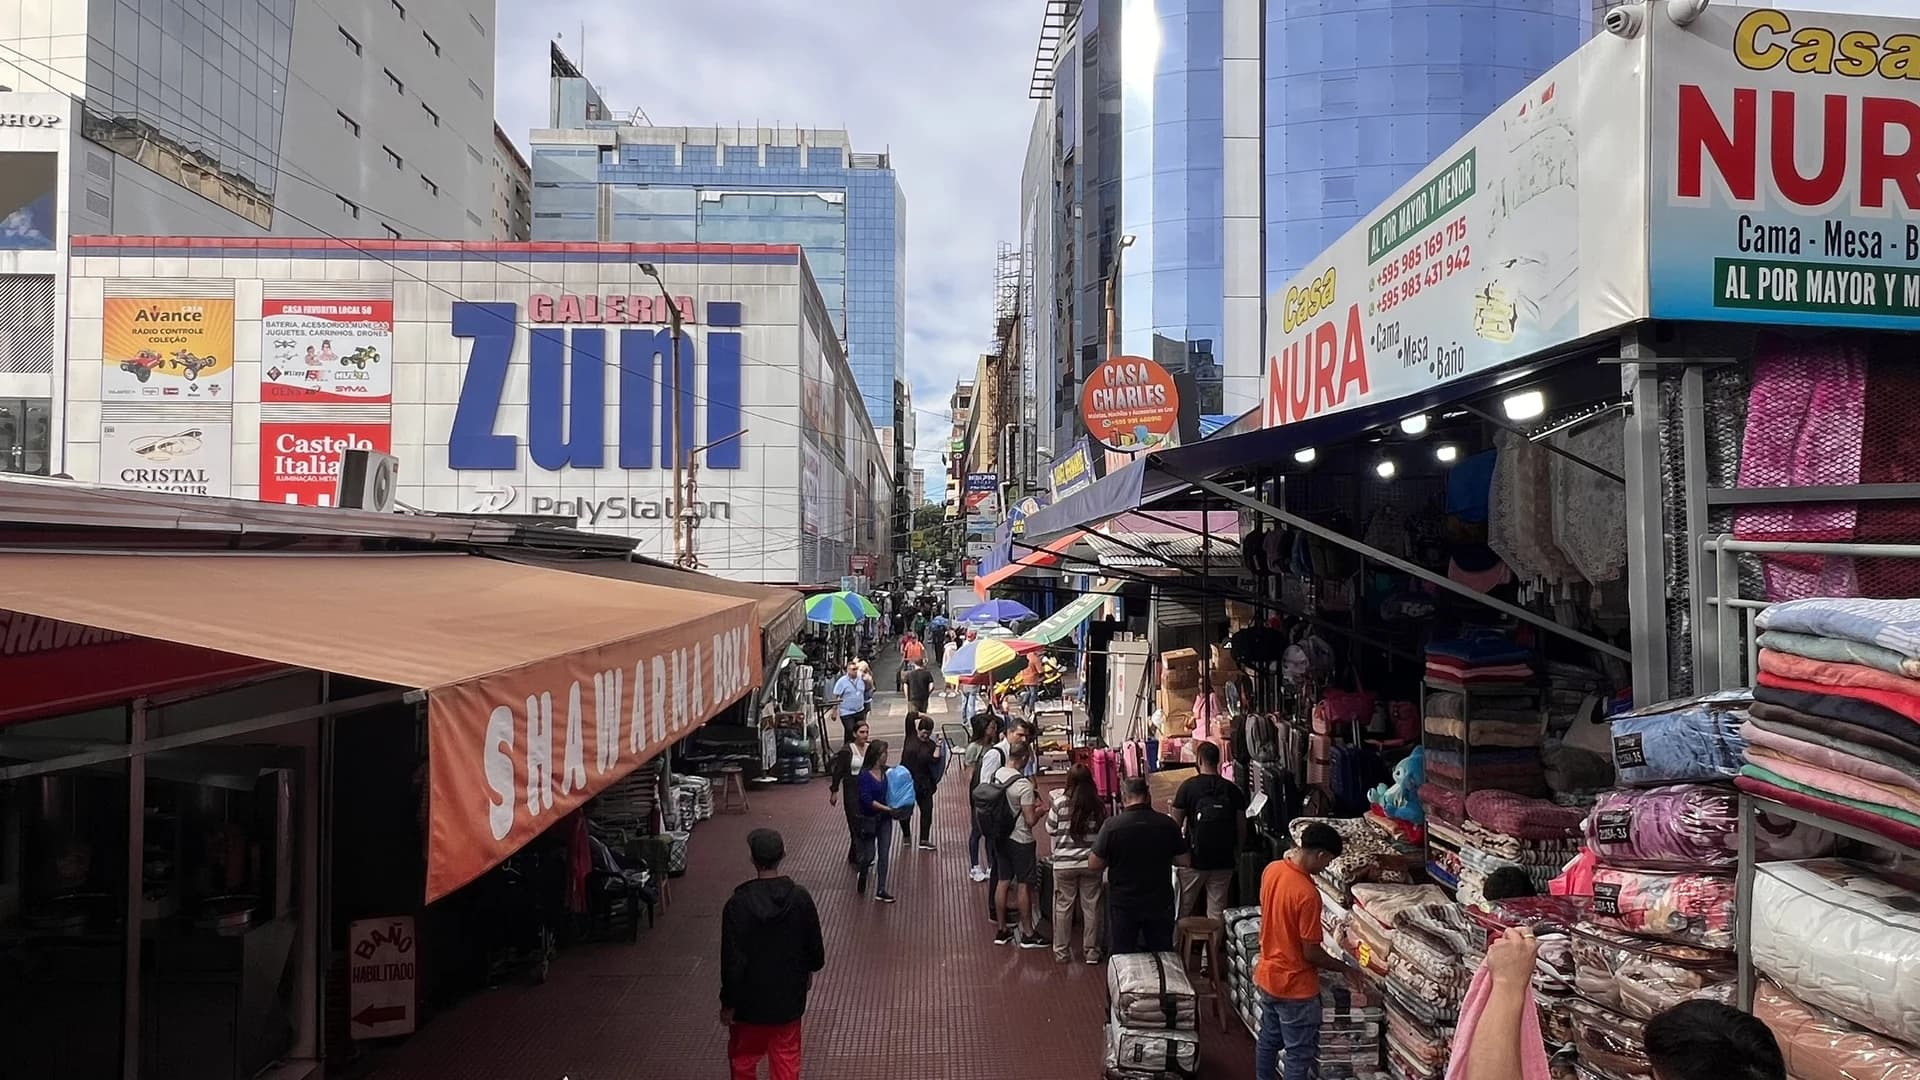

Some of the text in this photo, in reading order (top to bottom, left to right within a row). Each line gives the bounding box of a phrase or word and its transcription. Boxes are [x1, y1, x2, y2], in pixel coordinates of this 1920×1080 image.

[1733, 9, 1920, 80] Casa
[1371, 158, 1472, 257] AL POR MAYOR Y MENOR
[1376, 216, 1467, 287] +595 985 169 715
[1738, 215, 1800, 254] Cama
[1824, 220, 1882, 259] Mesa
[1376, 245, 1470, 313] +595 983 431 942
[1725, 265, 1750, 299] AL
[1758, 267, 1798, 302] POR
[1806, 270, 1876, 306] MAYOR
[1884, 273, 1896, 306] Y
[135, 307, 202, 322] Avance
[282, 305, 301, 314] CASA
[303, 305, 337, 314] FAVORITA
[338, 305, 360, 314] LOCAL
[528, 294, 697, 324] GALERIA
[1283, 266, 1336, 334] Casa
[1376, 321, 1400, 353] Cama
[1403, 335, 1428, 367] Mesa
[1104, 363, 1149, 387] CASA
[1269, 303, 1369, 428] NURA
[1437, 341, 1464, 380] Baño
[449, 301, 742, 470] Zuni
[1092, 384, 1166, 411] CHARLES
[276, 433, 373, 454] Castelo
[120, 468, 210, 483] CRISTAL
[531, 496, 731, 525] PolyStaton
[484, 641, 704, 841] SHAWARMA
[713, 626, 742, 705] BOX
[354, 922, 412, 960] BAÑO
[352, 962, 414, 984] HABILITADO
